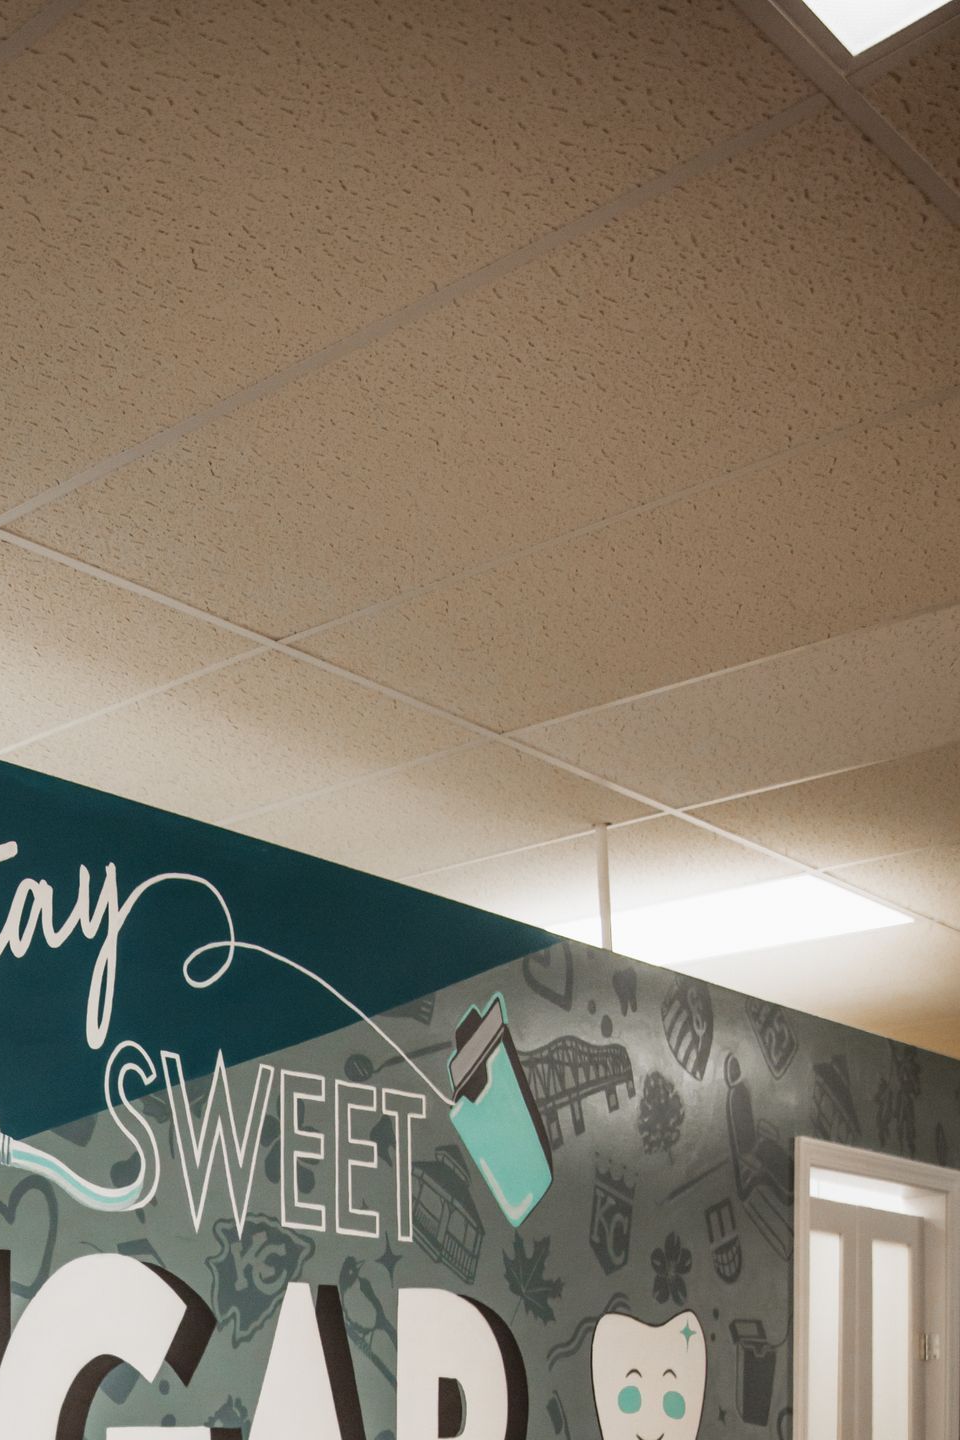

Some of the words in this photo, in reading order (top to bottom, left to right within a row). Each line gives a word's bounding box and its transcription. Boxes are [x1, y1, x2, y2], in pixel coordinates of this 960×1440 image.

[104, 1040, 426, 1242] SWEET
[230, 1231, 288, 1296] KC
[591, 1187, 629, 1265] KC
